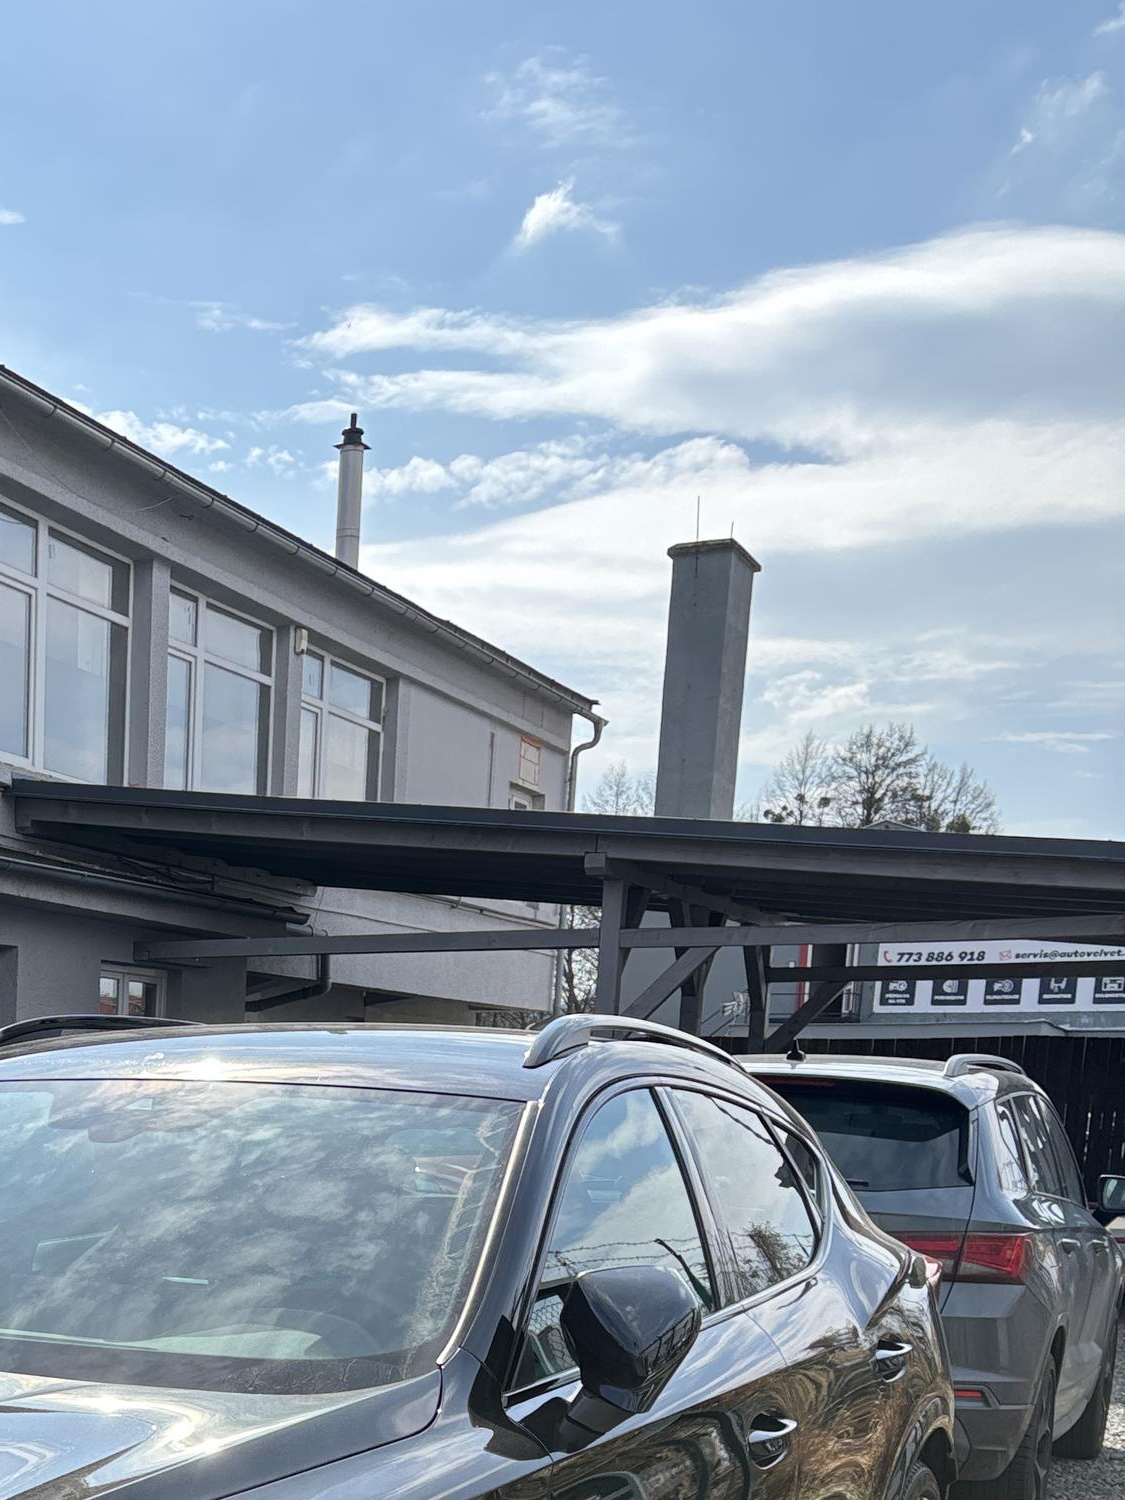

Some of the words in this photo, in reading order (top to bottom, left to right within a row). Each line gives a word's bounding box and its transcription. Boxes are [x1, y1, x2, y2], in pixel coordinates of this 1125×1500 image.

[897, 952, 922, 962] 773
[925, 952, 953, 962] 886
[958, 951, 986, 961] 918
